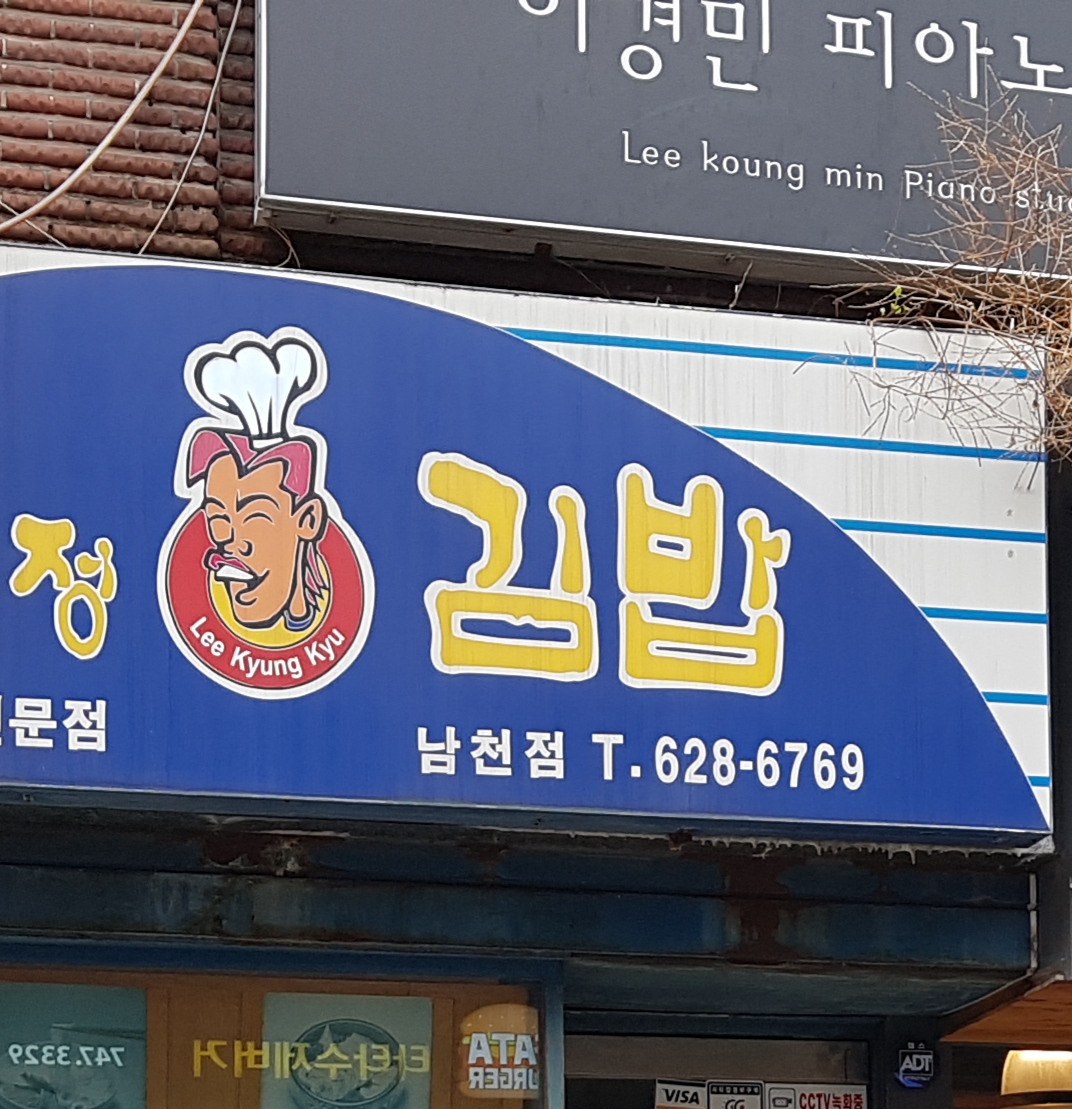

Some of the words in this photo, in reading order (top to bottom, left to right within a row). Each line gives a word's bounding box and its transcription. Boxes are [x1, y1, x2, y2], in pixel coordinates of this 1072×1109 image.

[824, 10, 1072, 98] 피아노
[621, 131, 681, 168] Lee
[702, 141, 805, 190] koung
[825, 164, 884, 192] min
[904, 169, 997, 204] Piano
[417, 451, 791, 696] 김밥
[189, 616, 225, 657] Lee
[230, 646, 303, 680] Kyung
[304, 627, 346, 666] Kyu
[417, 725, 566, 780] 남천점
[901, 1054, 933, 1072] ADT
[663, 1088, 700, 1105] VISA
